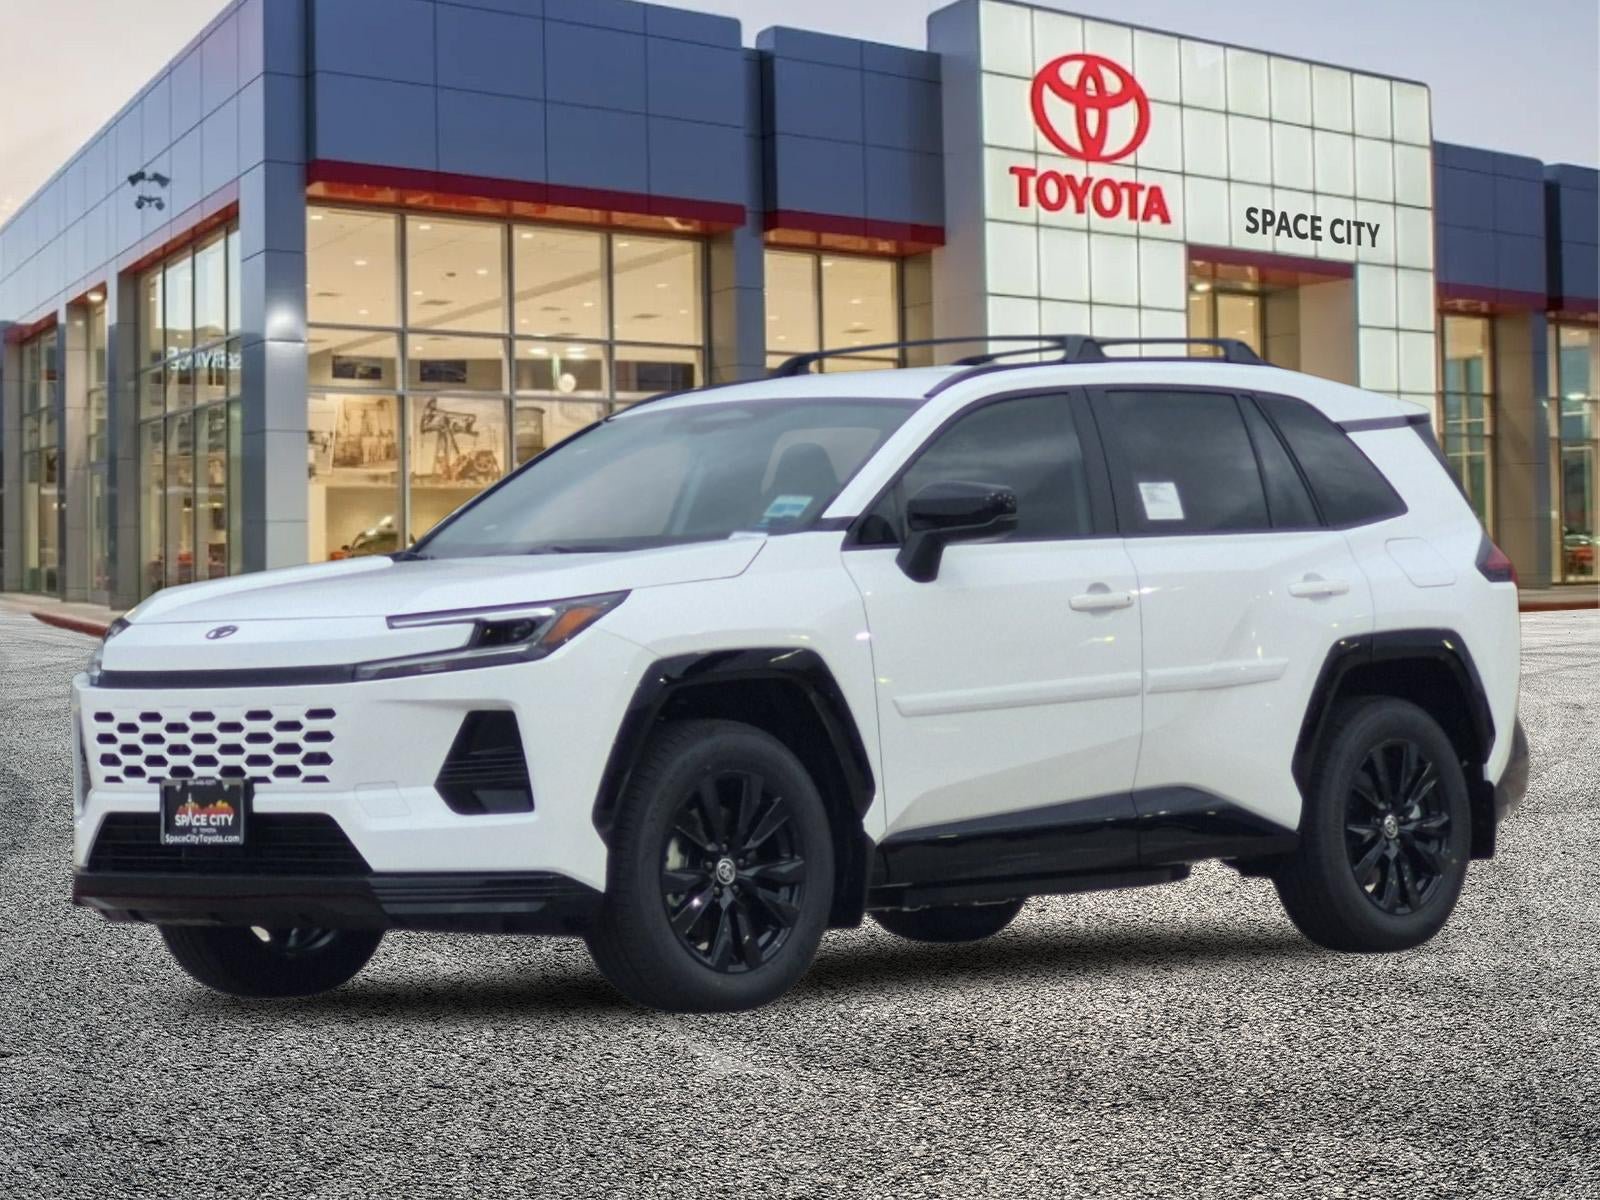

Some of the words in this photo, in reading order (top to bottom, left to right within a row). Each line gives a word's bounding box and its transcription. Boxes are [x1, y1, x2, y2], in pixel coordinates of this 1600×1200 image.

[1009, 166, 1171, 224] TOYOTA
[1245, 207, 1323, 242] SPACE
[1329, 218, 1381, 249] CITY
[175, 814, 207, 826] SPACE
[209, 814, 234, 826] CITY
[165, 834, 240, 844] SpaceCityToyota.com
